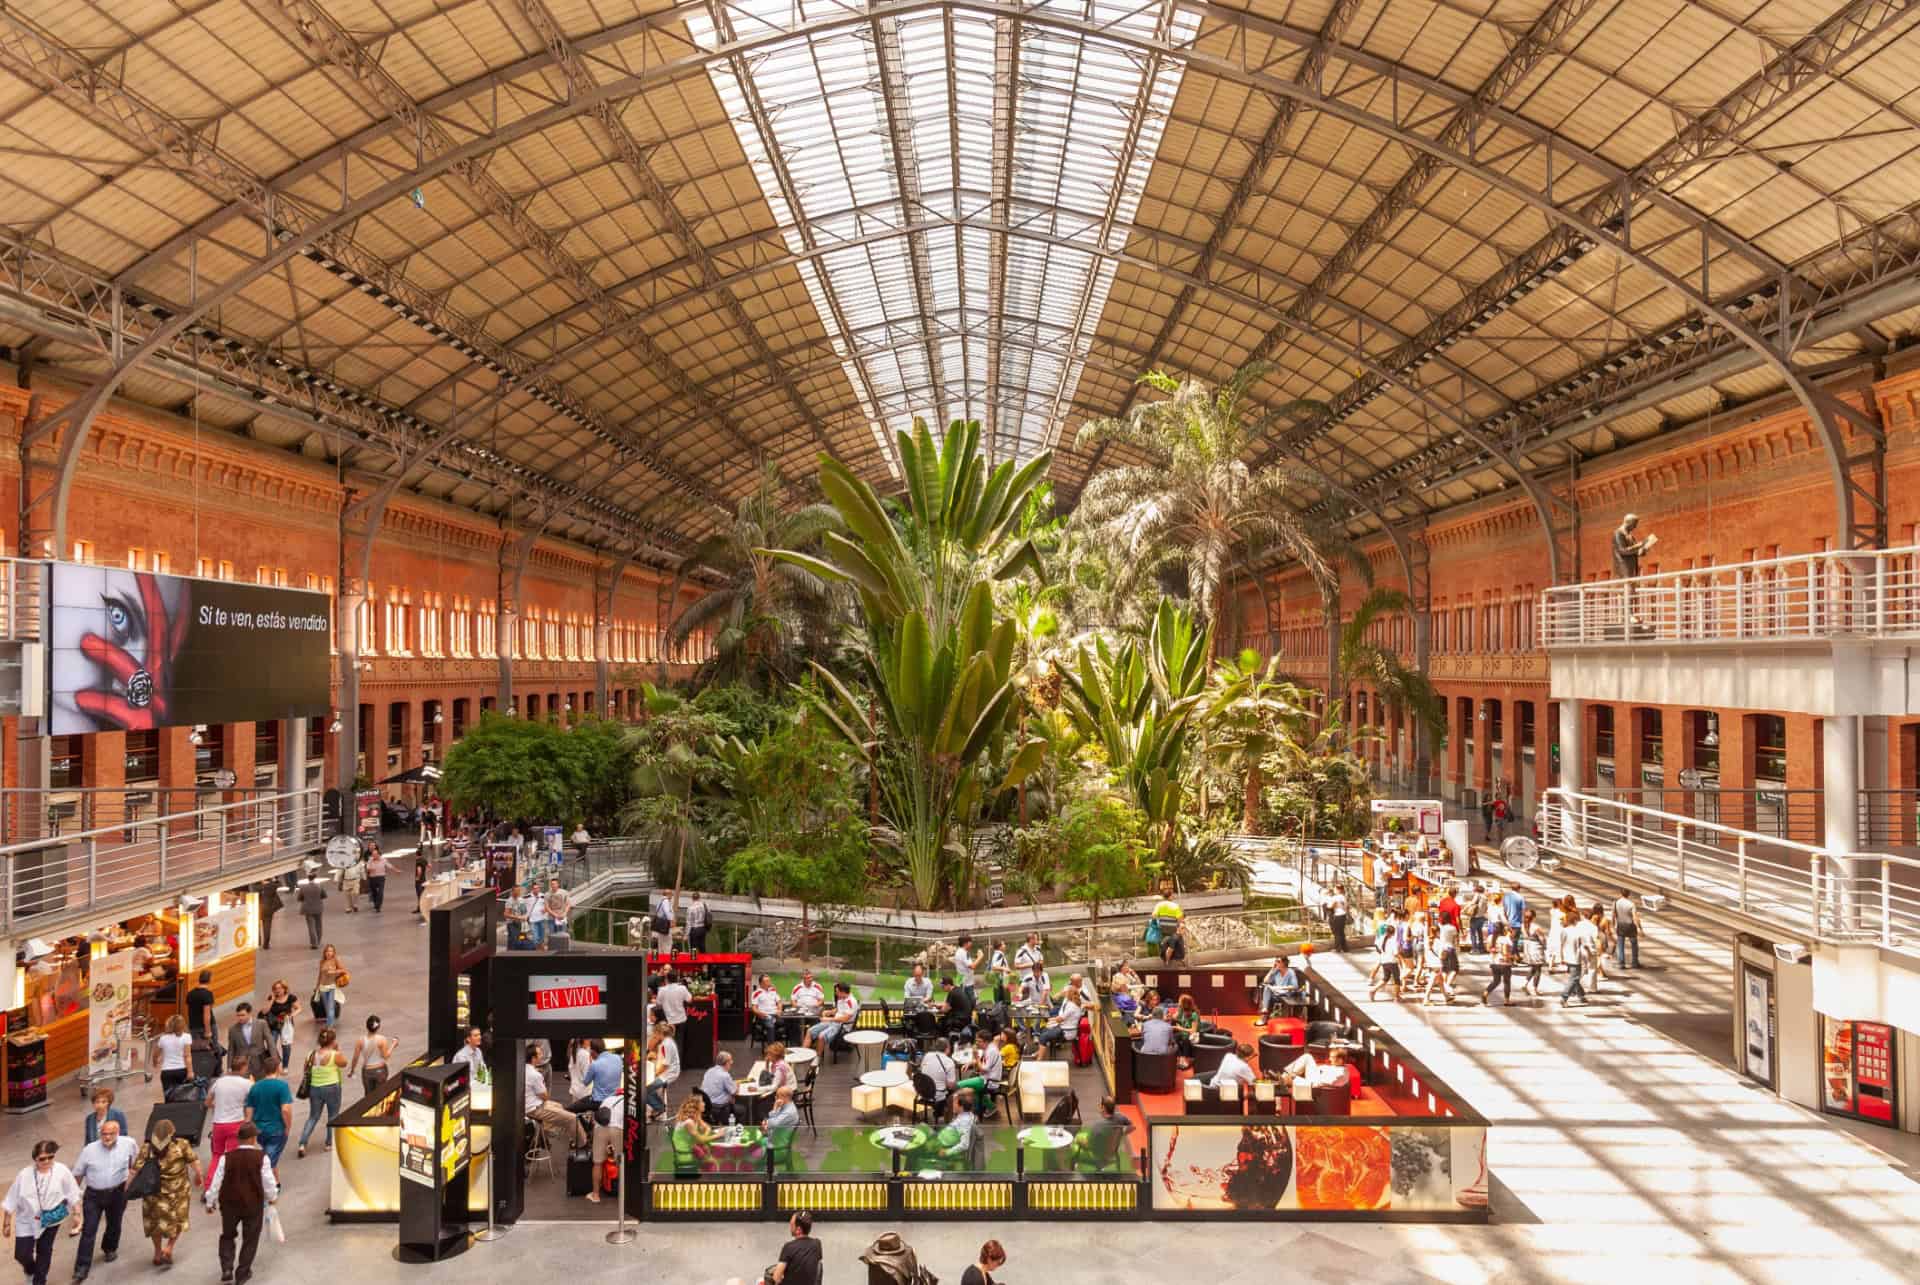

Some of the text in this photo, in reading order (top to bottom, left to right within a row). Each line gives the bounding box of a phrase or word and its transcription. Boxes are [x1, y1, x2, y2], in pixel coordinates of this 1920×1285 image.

[199, 605, 327, 632] Si te ven, estás vendido
[542, 987, 594, 1009] EN VIVO
